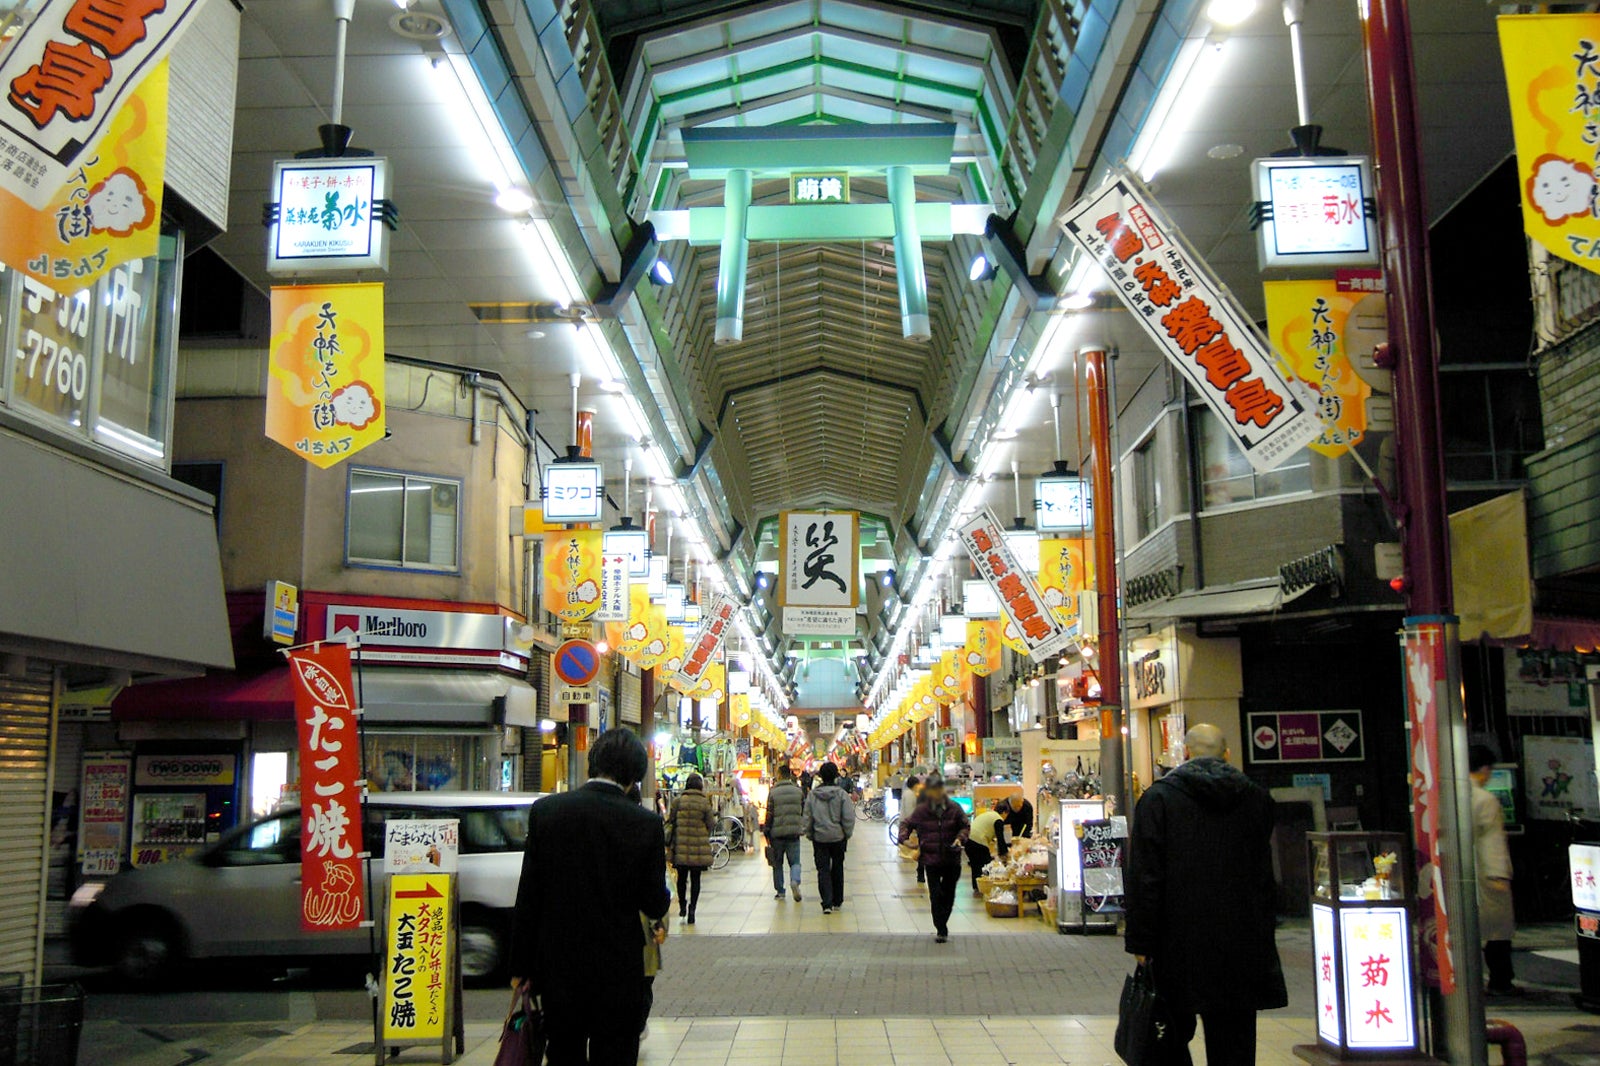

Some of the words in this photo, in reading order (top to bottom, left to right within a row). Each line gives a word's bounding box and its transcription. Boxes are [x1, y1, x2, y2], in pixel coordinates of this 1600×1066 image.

[554, 486, 592, 500] ミワコ
[366, 615, 427, 638] Marlboro
[304, 665, 342, 704] 味自慢
[562, 691, 591, 700] 自動車
[182, 763, 221, 773] DOWN
[306, 705, 354, 859] たこ焼
[391, 912, 416, 1029] 大玉たこ焼
